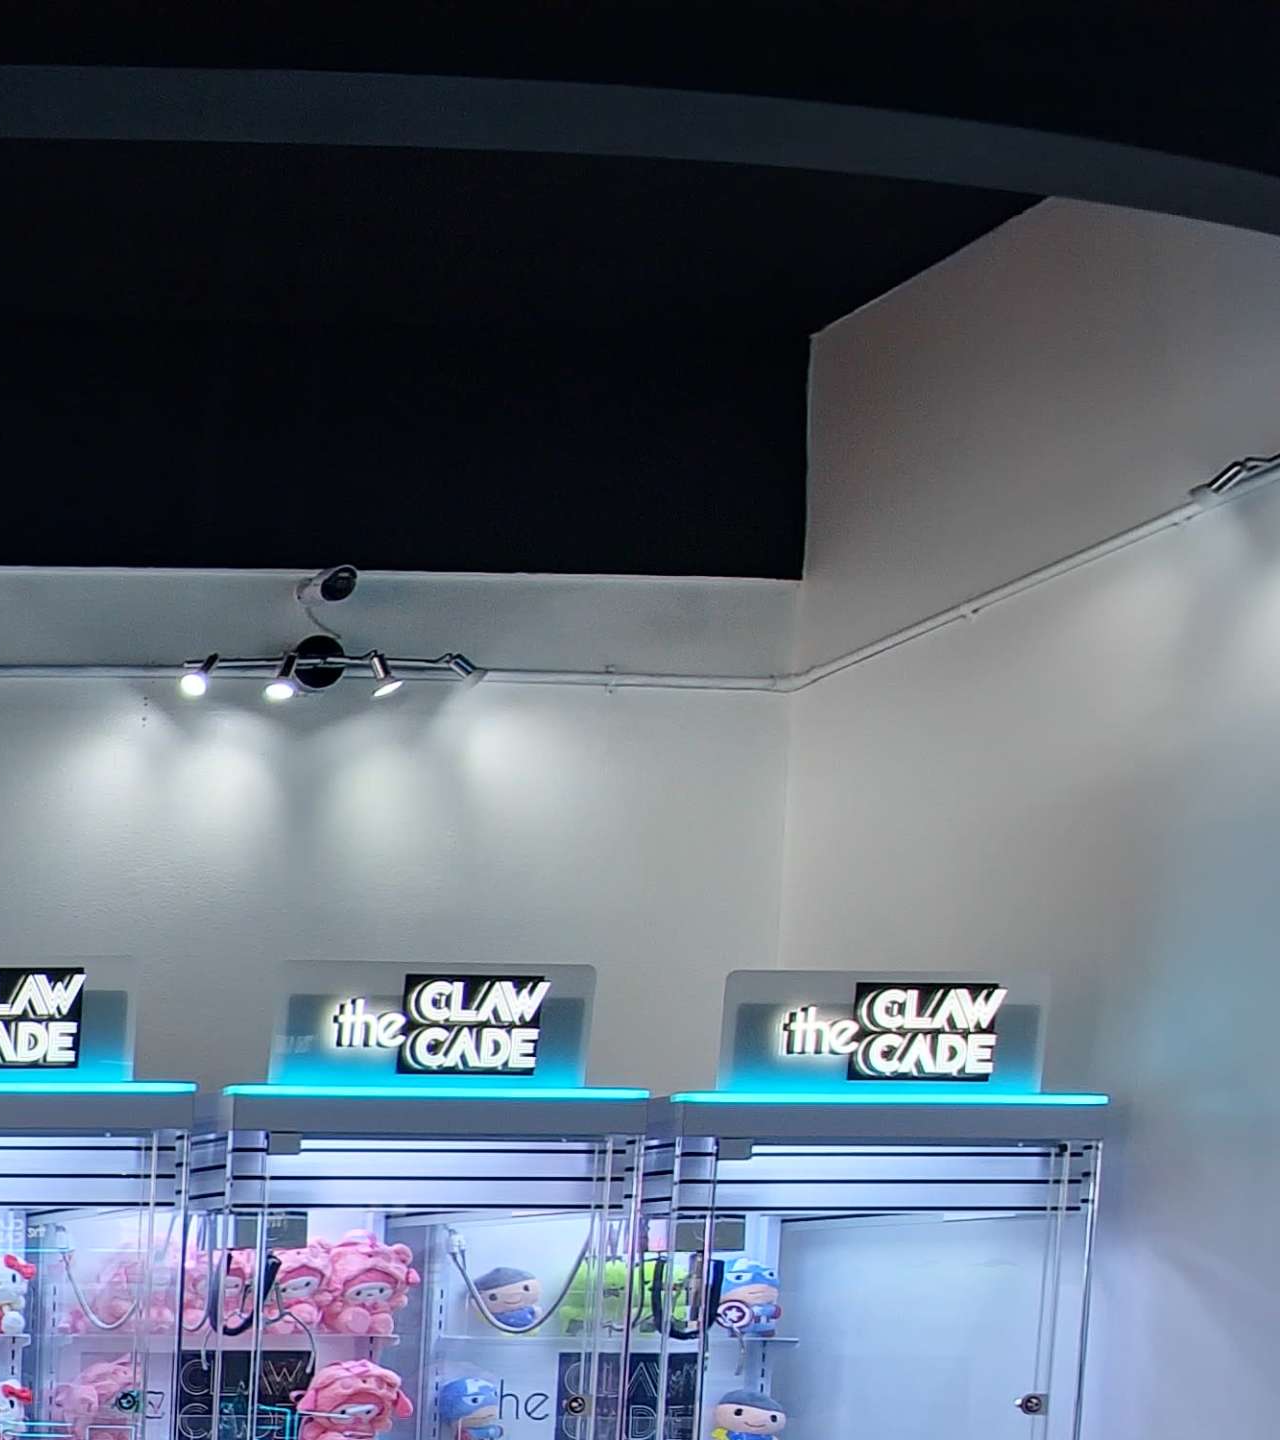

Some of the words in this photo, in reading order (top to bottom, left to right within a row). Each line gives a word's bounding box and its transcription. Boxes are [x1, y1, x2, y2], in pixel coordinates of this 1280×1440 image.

[333, 997, 408, 1047] the
[410, 979, 551, 1024] CLAW
[781, 1004, 859, 1054] the
[858, 988, 1008, 1031] CLAW
[405, 1027, 539, 1069] CADE
[854, 1032, 997, 1075] CADE
[499, 1379, 550, 1421] he
